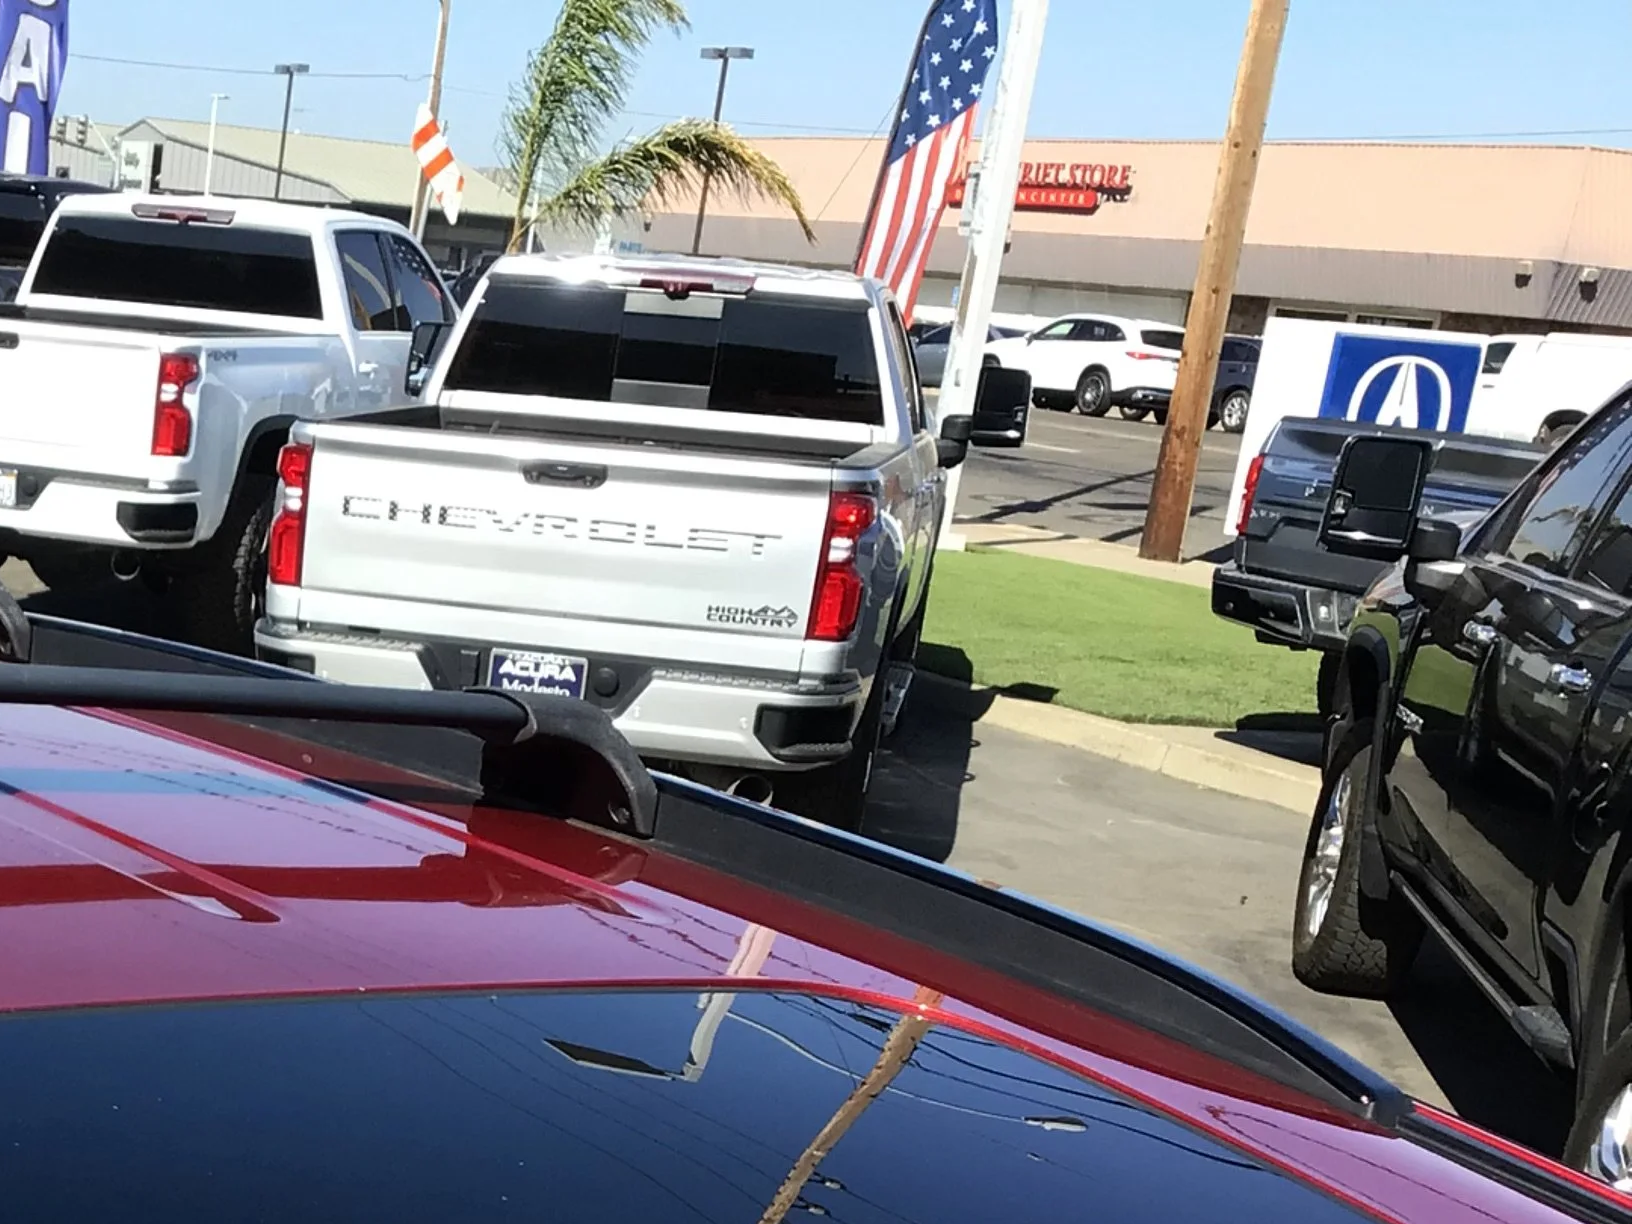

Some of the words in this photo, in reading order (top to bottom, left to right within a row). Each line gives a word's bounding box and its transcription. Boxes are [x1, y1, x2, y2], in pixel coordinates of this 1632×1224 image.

[1067, 163, 1133, 189] STORE
[343, 495, 783, 556] CHEVROLET
[706, 613, 798, 628] COUNTRY
[708, 605, 753, 616] HIGH
[498, 659, 576, 682] ACURA
